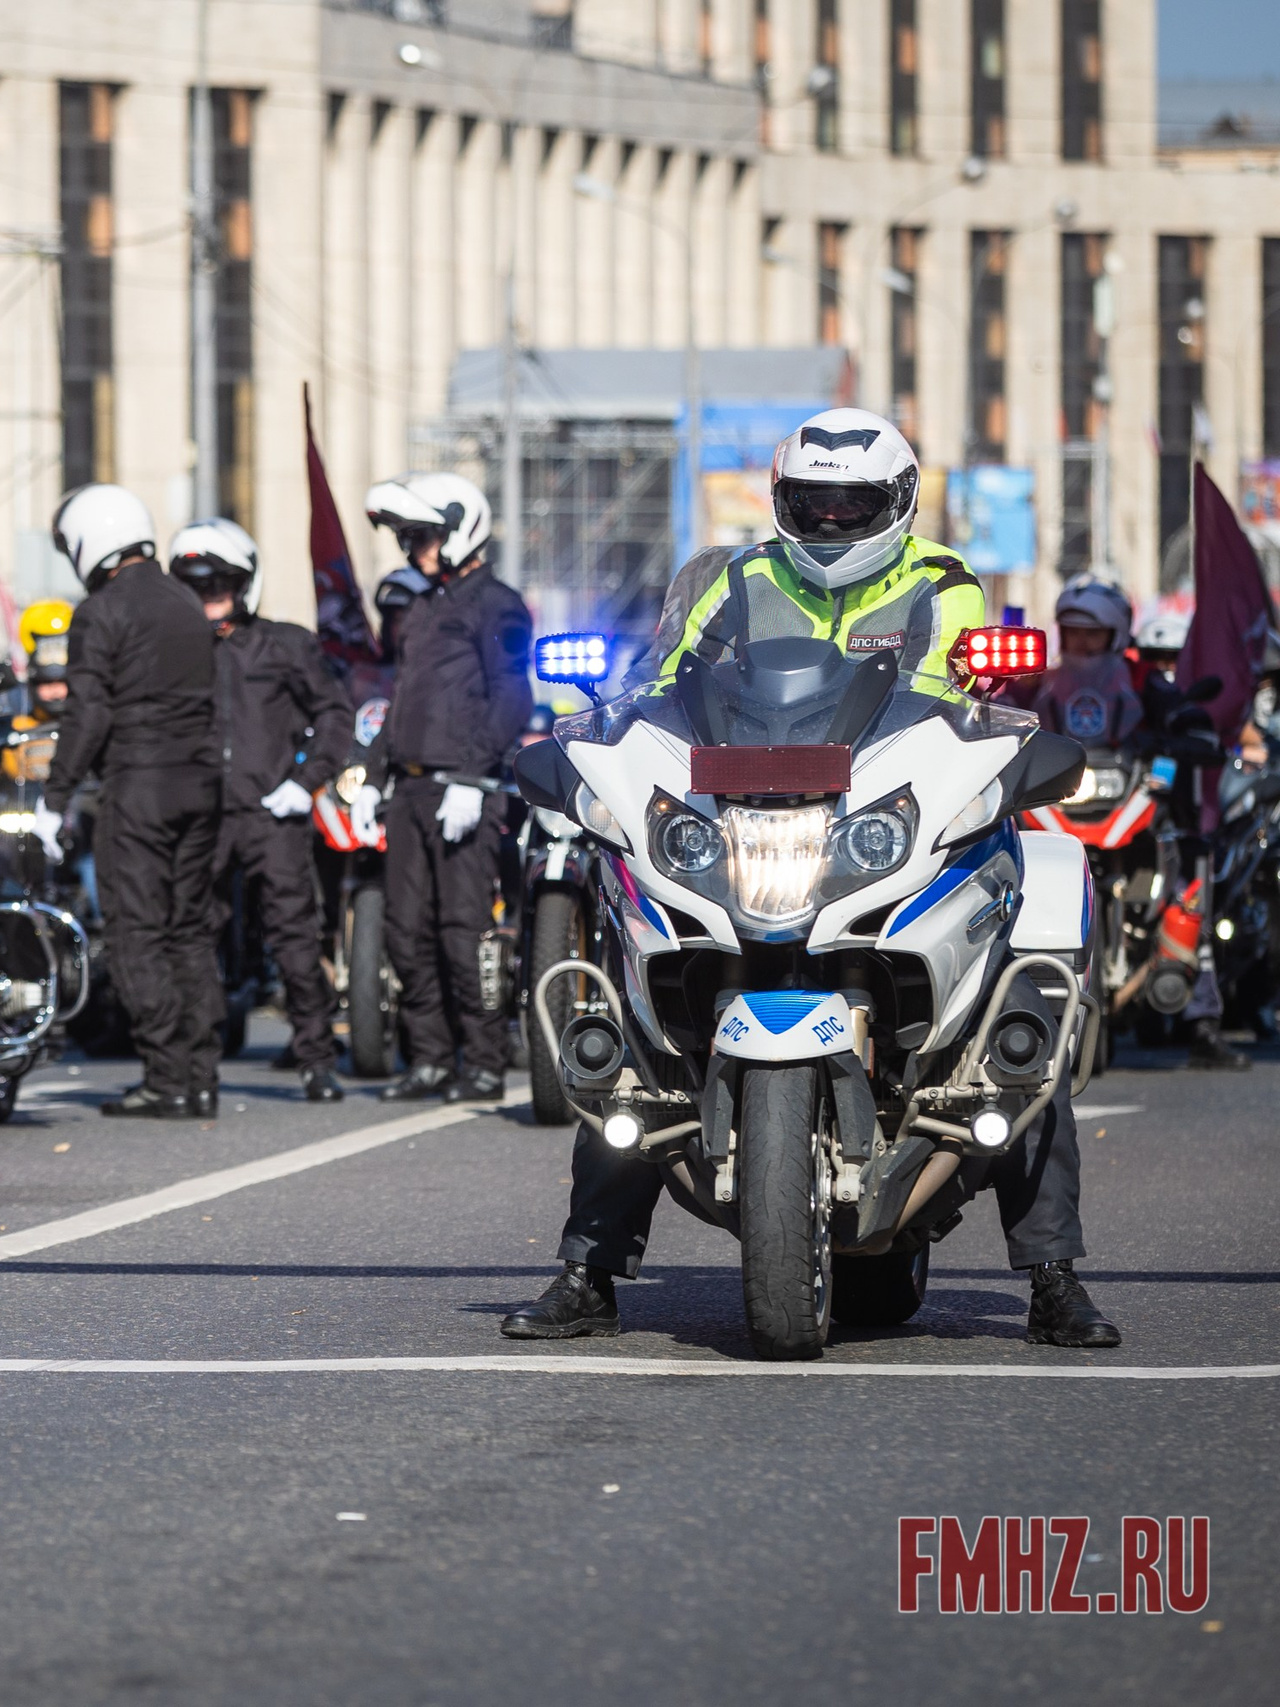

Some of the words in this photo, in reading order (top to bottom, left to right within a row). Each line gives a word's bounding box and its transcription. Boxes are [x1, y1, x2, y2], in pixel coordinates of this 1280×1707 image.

[850, 637, 872, 649] ДПС
[873, 634, 901, 648] ГИБДД
[720, 1016, 750, 1042] ДПС
[811, 1016, 845, 1046] ДПС
